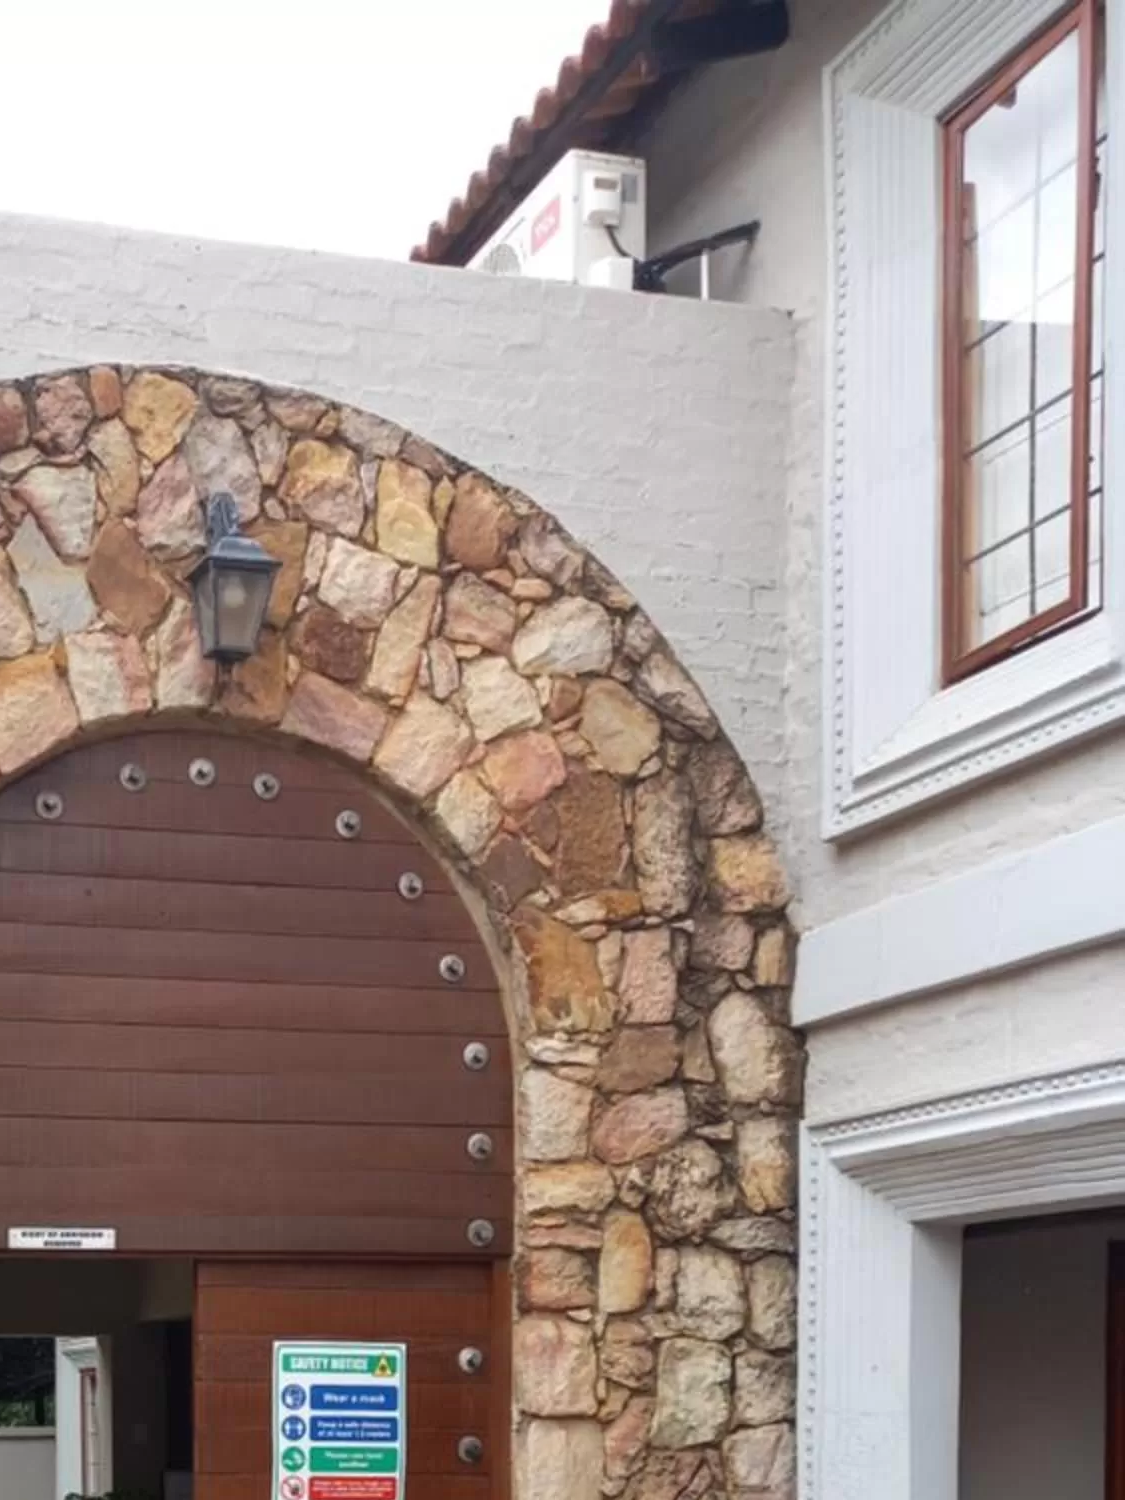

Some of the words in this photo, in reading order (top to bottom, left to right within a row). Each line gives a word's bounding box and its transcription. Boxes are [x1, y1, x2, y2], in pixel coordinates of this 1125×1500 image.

[290, 1356, 330, 1370] SAFETY
[331, 1356, 368, 1370] NOTICE
[323, 1392, 349, 1404] Wear
[360, 1392, 386, 1404] mask
